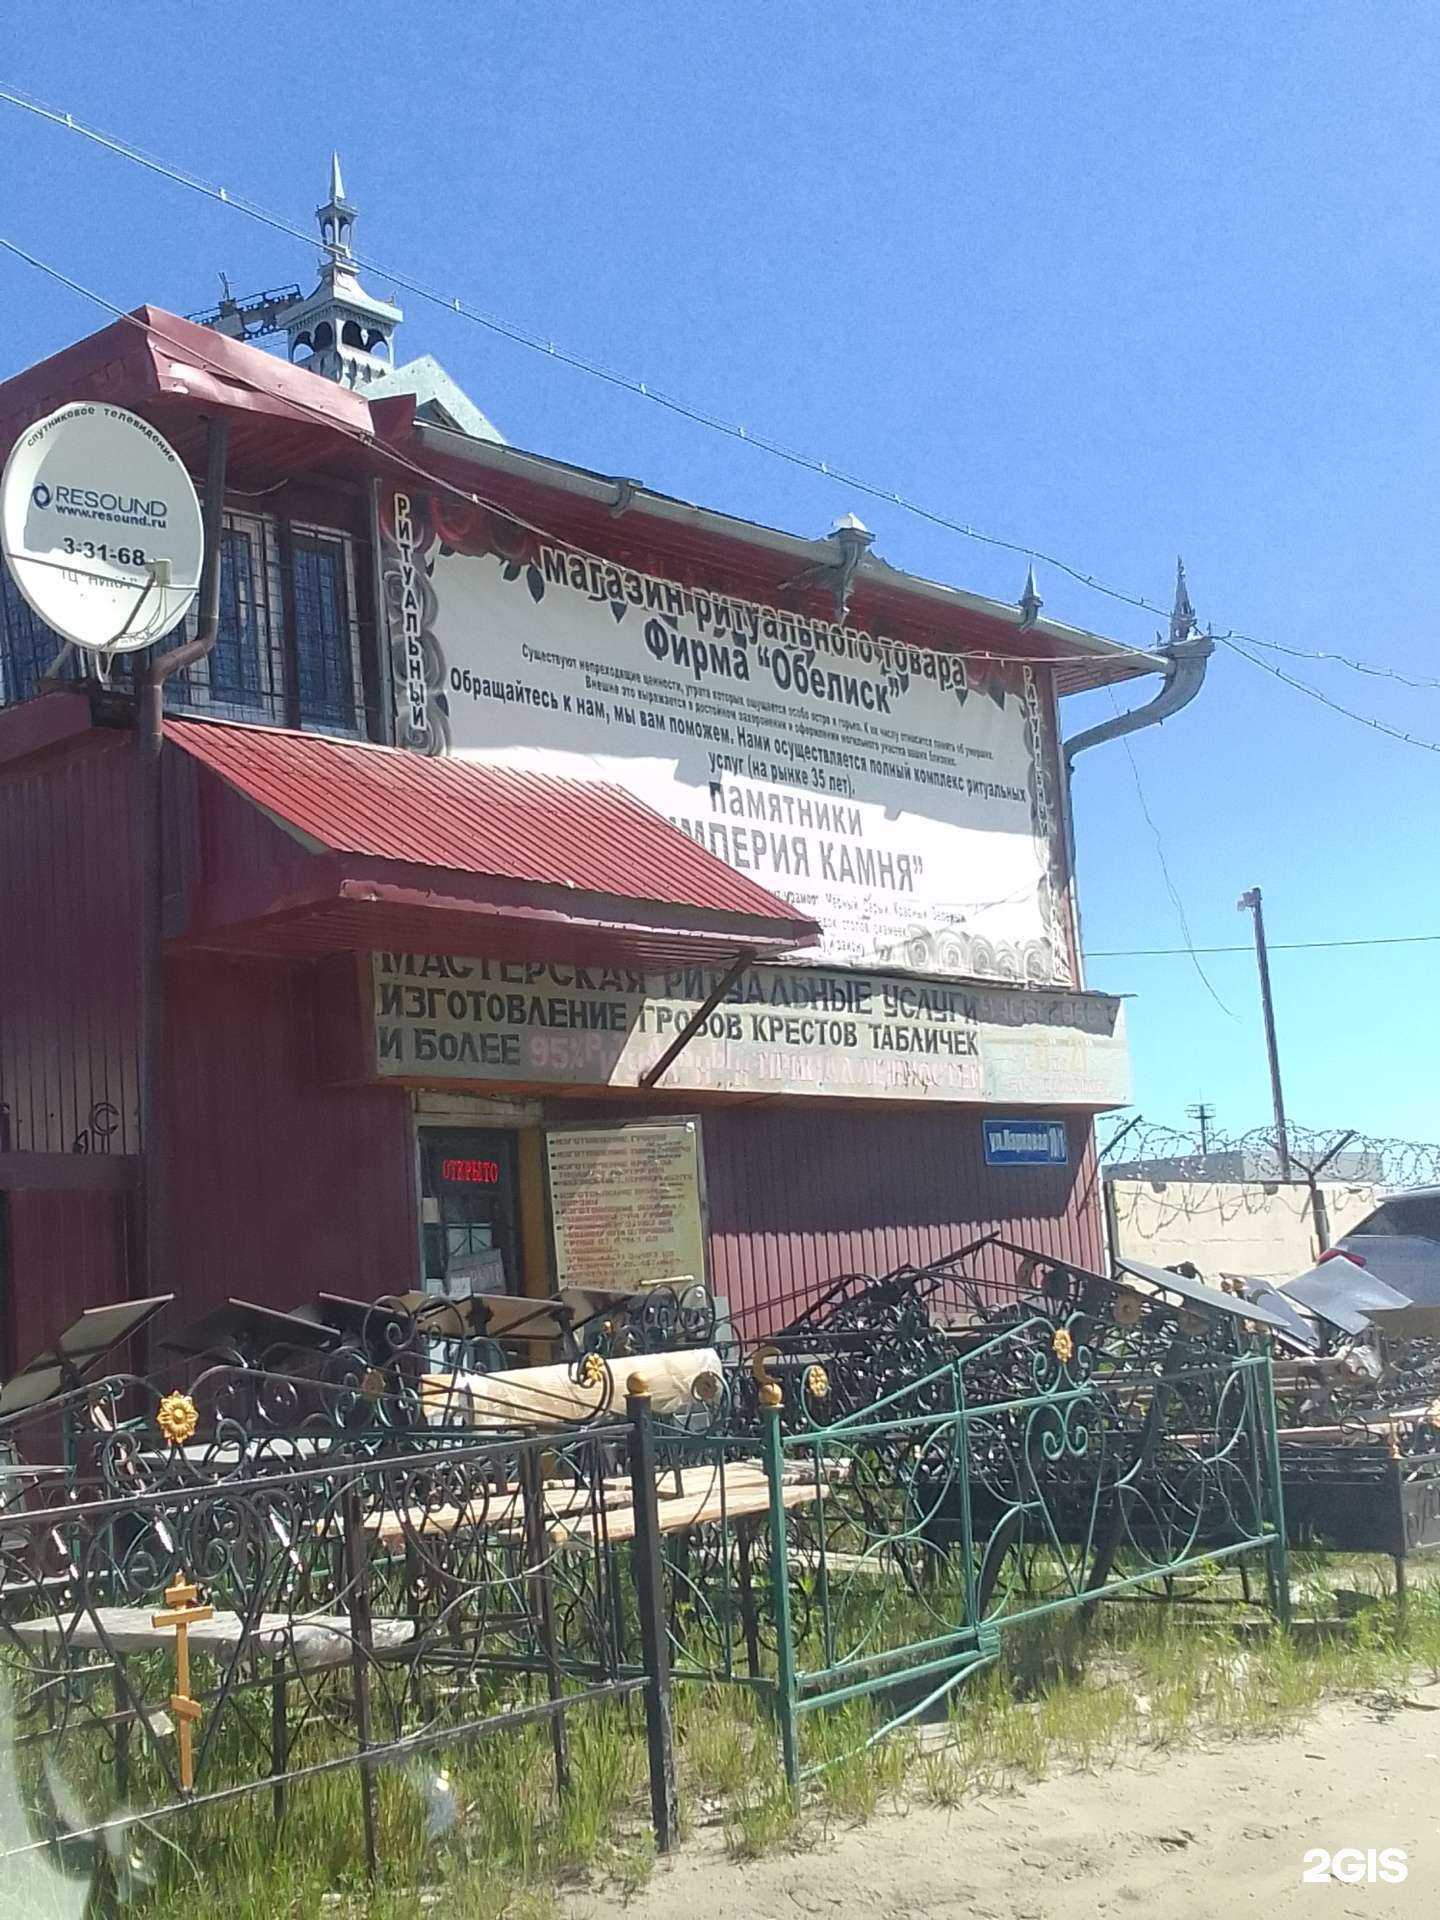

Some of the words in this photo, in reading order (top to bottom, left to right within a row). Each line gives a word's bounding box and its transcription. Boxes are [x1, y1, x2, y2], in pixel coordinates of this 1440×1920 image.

[28, 406, 95, 447] спутниковое
[104, 408, 175, 463] телевидение
[56, 486, 168, 518] RESOUND
[56, 504, 167, 529] www.resound.ru
[63, 537, 146, 566] 3-31-68
[541, 546, 684, 616] магазин
[691, 587, 872, 664] ритуального
[878, 636, 965, 690] товара
[521, 643, 577, 669] Существуют
[645, 617, 750, 681] Фирма
[450, 667, 558, 710] Обращайтесь
[562, 694, 572, 712] к
[576, 697, 610, 724] нам,
[614, 704, 636, 725] мы
[640, 710, 666, 731] вам
[669, 716, 734, 745] поможем.
[737, 726, 771, 752] Нами
[774, 738, 867, 774] осуществляется
[870, 759, 911, 780] полный
[913, 767, 964, 791] комплекс
[966, 778, 1027, 802] ритуальных
[707, 752, 744, 774] услуг
[747, 754, 767, 779] (на
[770, 762, 808, 786] рынке
[811, 767, 826, 788] 35
[379, 983, 627, 1032] ИЗГОТОВЛЕНИЕ
[750, 1013, 858, 1047] КРЕСТОВ
[868, 1022, 979, 1056] ТАБЛИЧЕК
[882, 983, 978, 1025] УСЛУГИ
[379, 1026, 402, 1060] И
[414, 1028, 520, 1066] БОЛЕЕ
